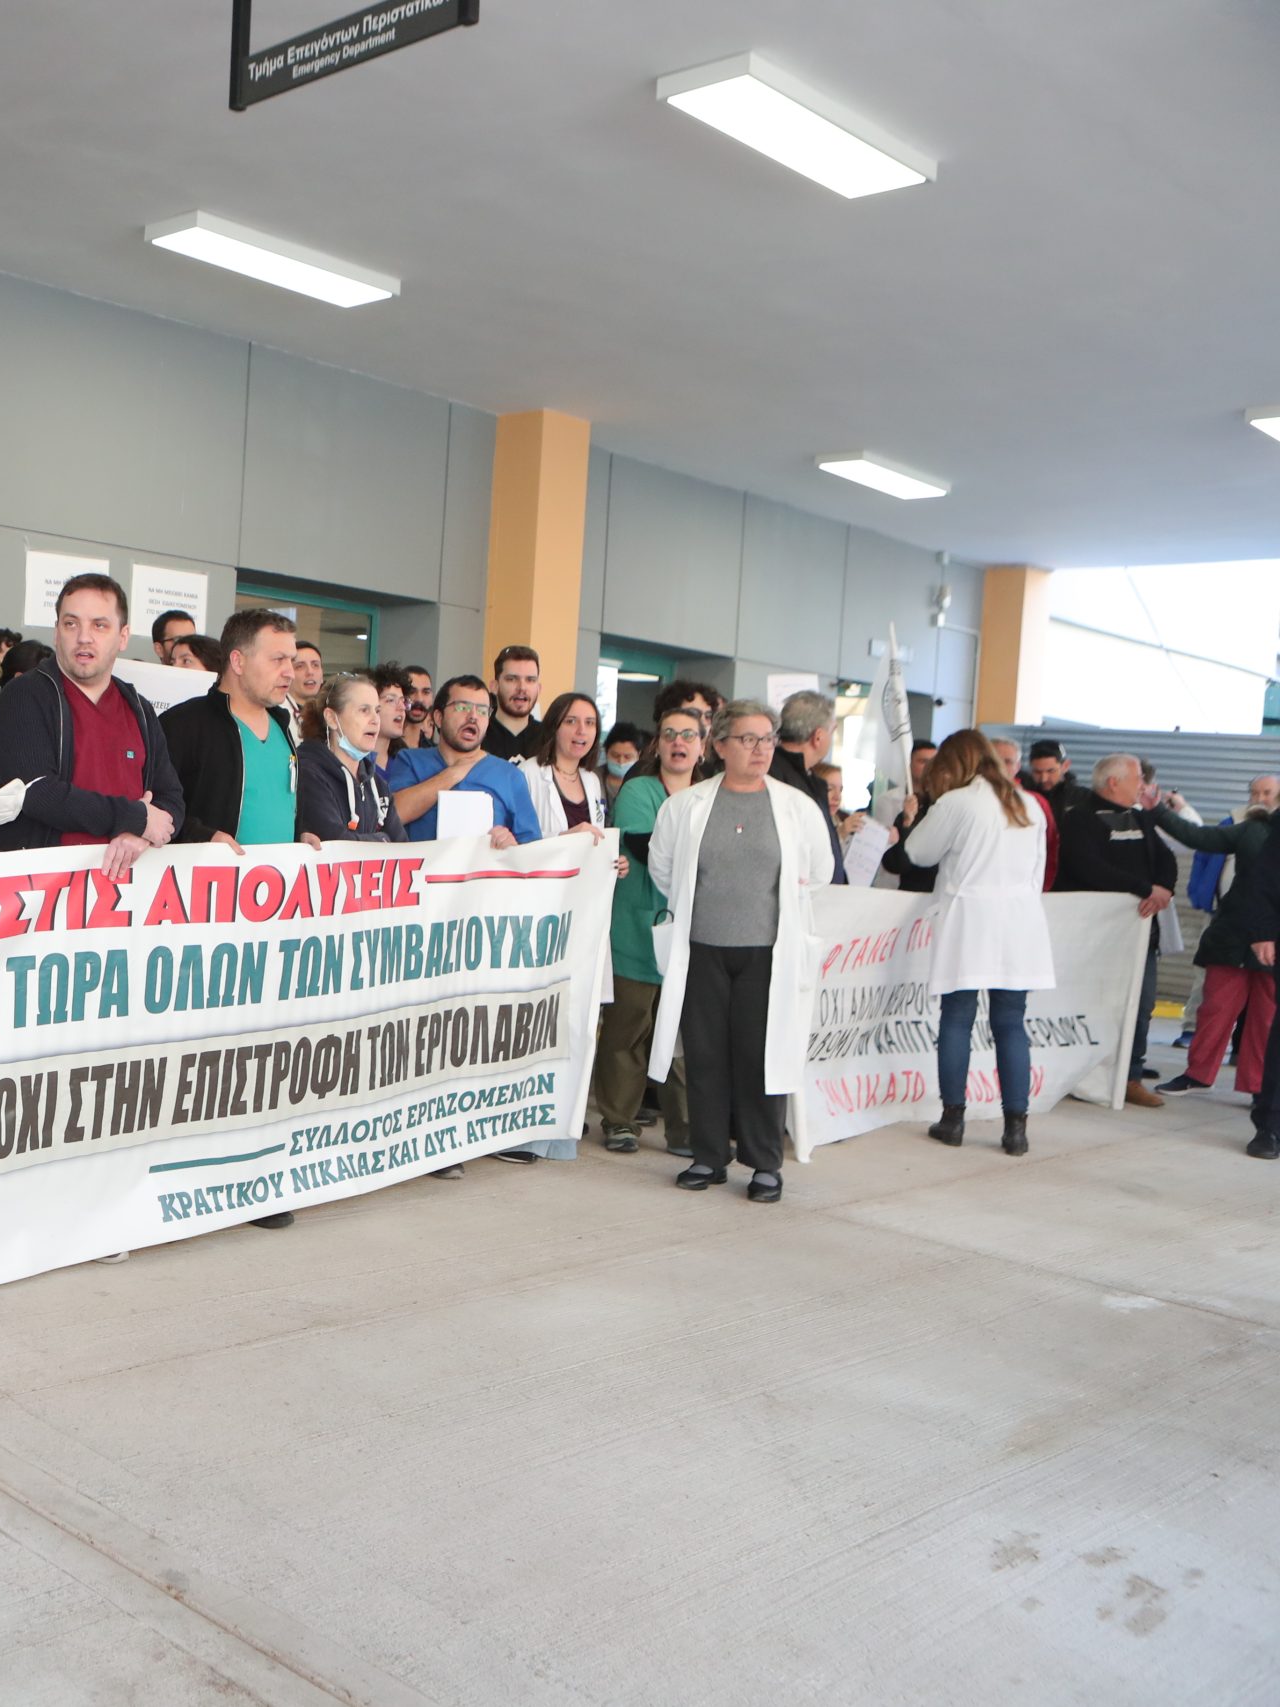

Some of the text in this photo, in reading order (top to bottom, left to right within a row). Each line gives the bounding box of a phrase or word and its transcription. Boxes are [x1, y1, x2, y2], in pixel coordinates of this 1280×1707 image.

[248, 0, 450, 81] Τμήμα Επειγόντων Περιστατικ
[292, 28, 396, 79] Emergency Department
[143, 857, 426, 925] ΑΠΟΛΥΣΕΙΣ
[6, 950, 129, 1028] ΤΩΡΑ
[144, 941, 269, 1014] ΟΛΩΝ
[278, 934, 346, 1002] ΤΩΝ
[351, 910, 574, 990] ΣΥΜΒΑΣΙΟΥΧΩΝ
[822, 928, 902, 980] ΦΤΑΝΕΙ
[820, 988, 846, 1028] ΟΧΙ
[63, 1054, 168, 1142] ΣΤΗΝ
[171, 1029, 360, 1126] ΕΠΙΣΤΡΟΦΗ
[367, 1017, 412, 1093] ΤΩΝ
[414, 992, 560, 1078] ΕΡΓΟΛΑΒΩΝ
[290, 1072, 556, 1156] ΣΥΛΛΟΓΟΣ ΕΡΓΑΖΟΜΕΝΩΝ
[157, 1104, 557, 1223] ΚΡΑΤΙΚΟΥ ΝΙΚΑΙΑΣ ΚΑΙ ΔΥΤ. ΑΤΤΙΚΗΣ
